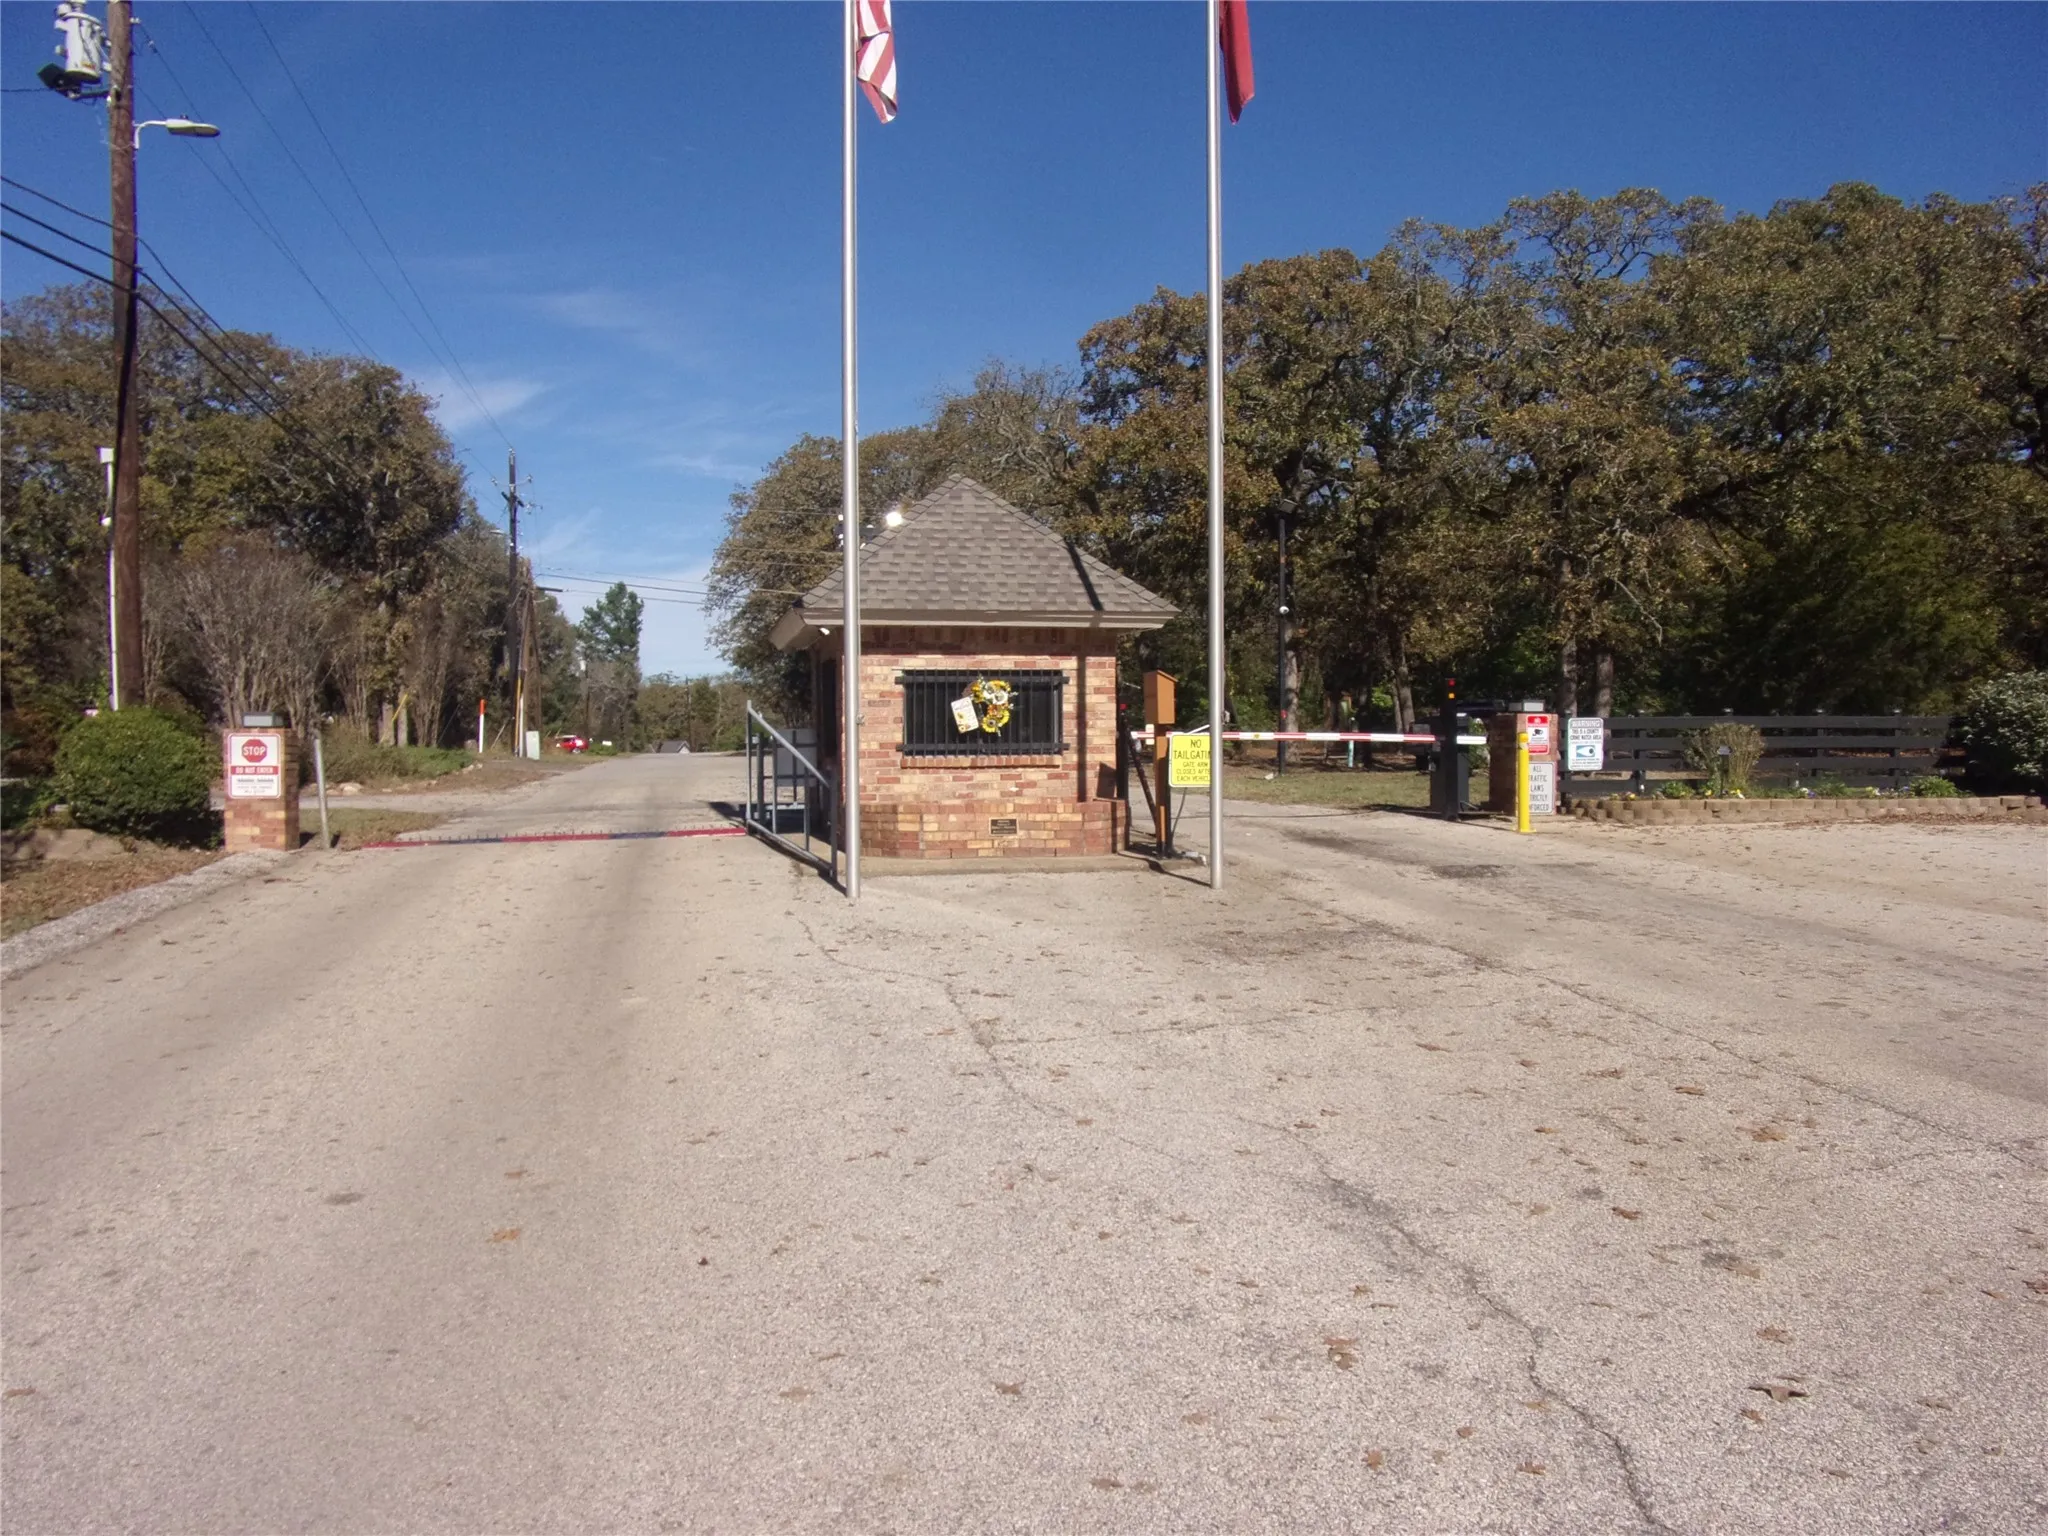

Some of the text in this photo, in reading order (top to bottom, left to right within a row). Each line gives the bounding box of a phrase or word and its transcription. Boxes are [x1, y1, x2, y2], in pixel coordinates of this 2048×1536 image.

[1190, 739, 1202, 748] NO
[243, 746, 266, 756] STOP
[1174, 750, 1212, 760] TAILGATIN
